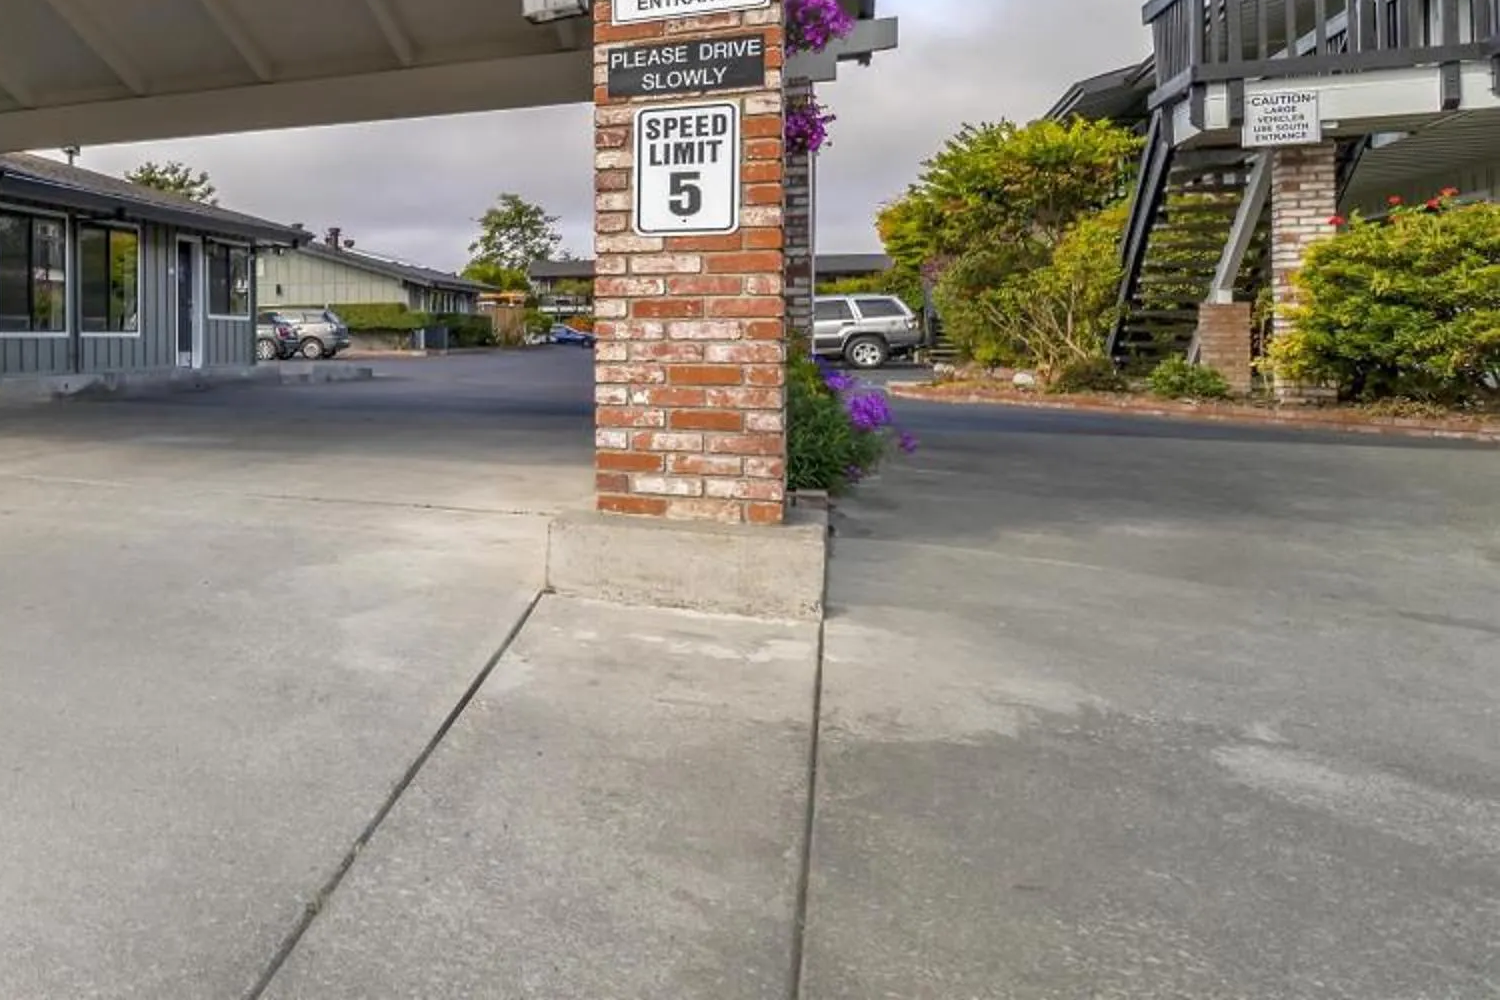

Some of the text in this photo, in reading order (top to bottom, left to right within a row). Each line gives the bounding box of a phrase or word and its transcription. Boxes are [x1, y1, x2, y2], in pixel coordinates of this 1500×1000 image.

[611, 39, 761, 69] PLEASE DRIVE
[641, 66, 727, 90] SLOWLY
[646, 114, 727, 140] SPEED
[649, 140, 723, 166] LIMIT
[668, 171, 703, 217] 5
